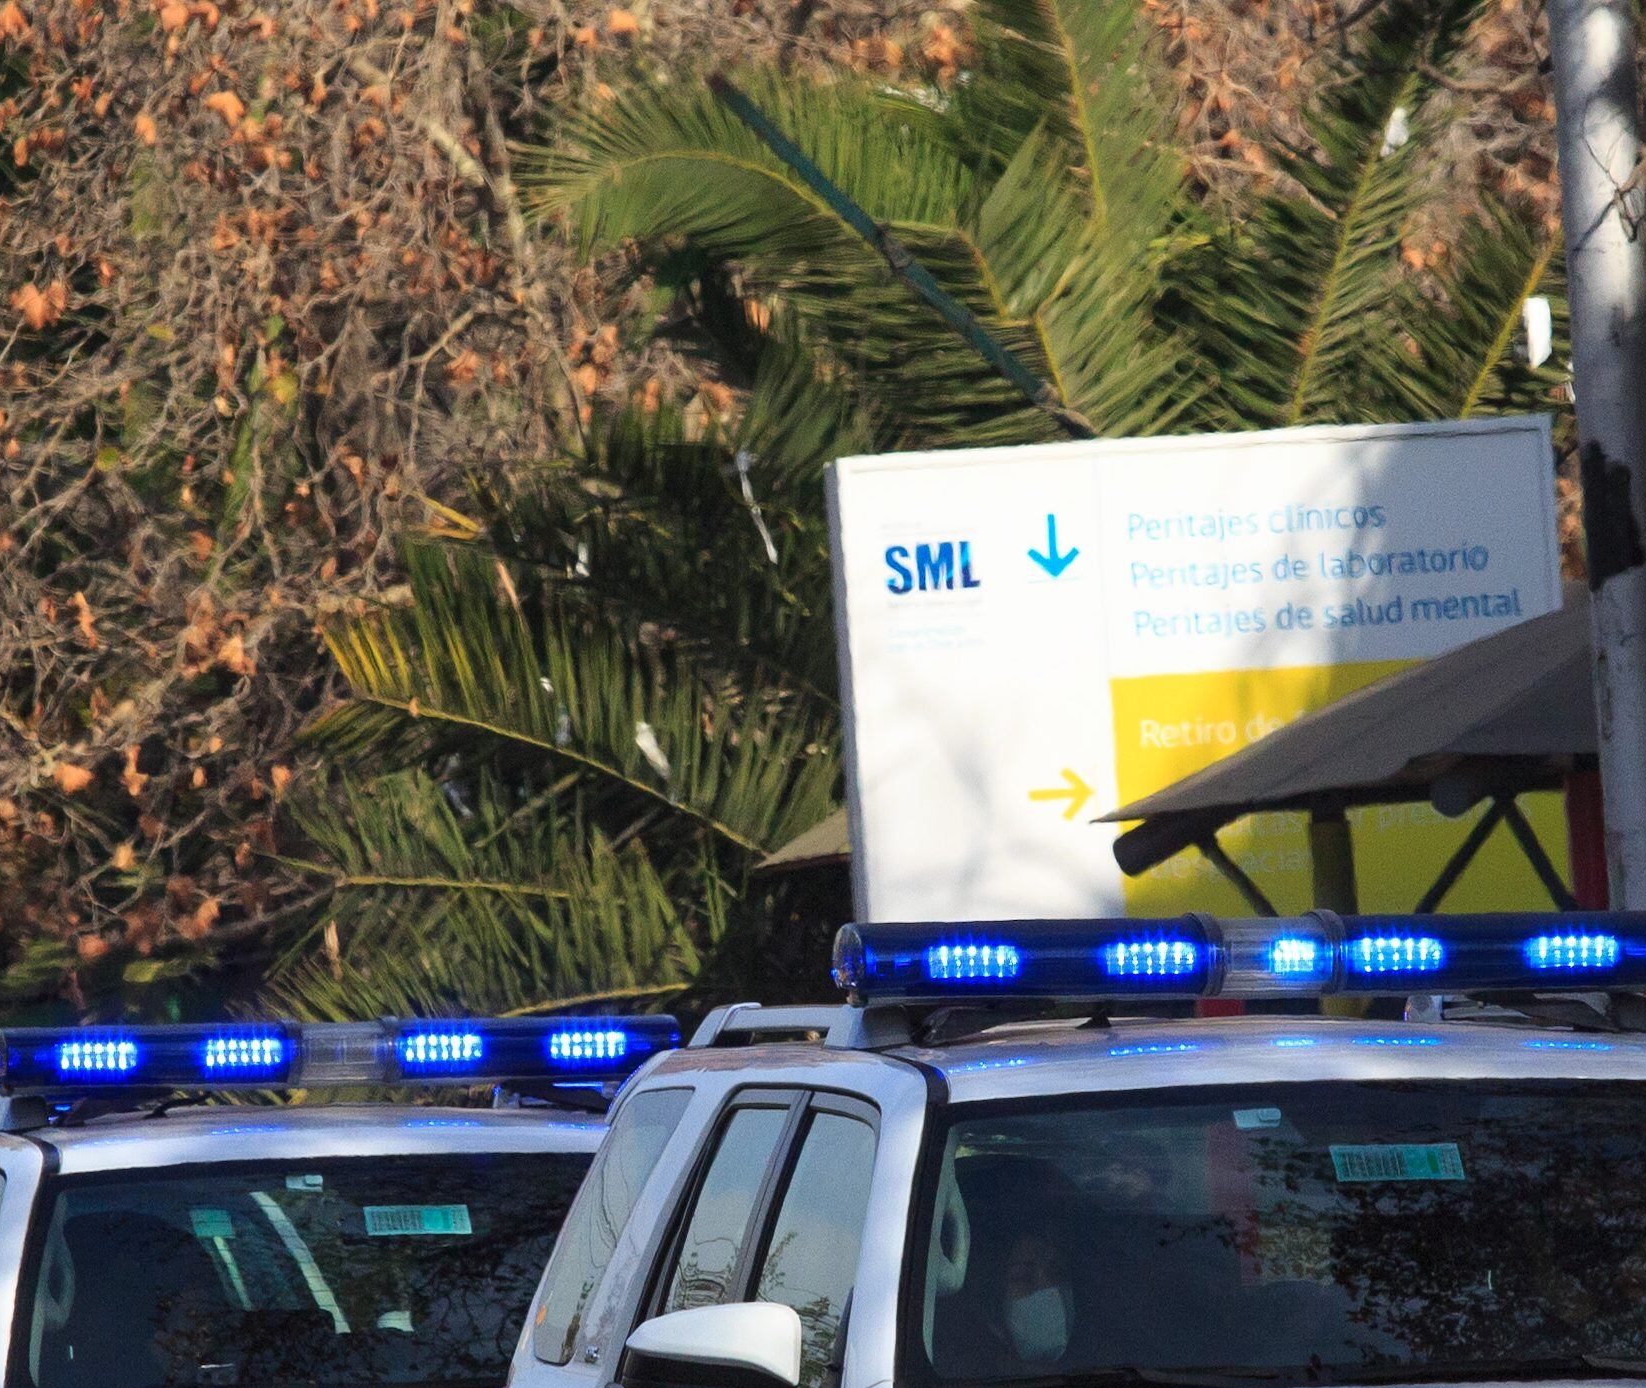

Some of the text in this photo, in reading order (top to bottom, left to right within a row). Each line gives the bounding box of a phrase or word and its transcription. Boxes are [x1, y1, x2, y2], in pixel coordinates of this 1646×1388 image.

[1127, 504, 1387, 542] Peritajes clínicos
[885, 541, 981, 595] SML
[1131, 541, 1490, 590] Peritajes de laboratorio
[1134, 588, 1523, 639] Peritajes de salud mental
[1140, 717, 1237, 749] Retiro
